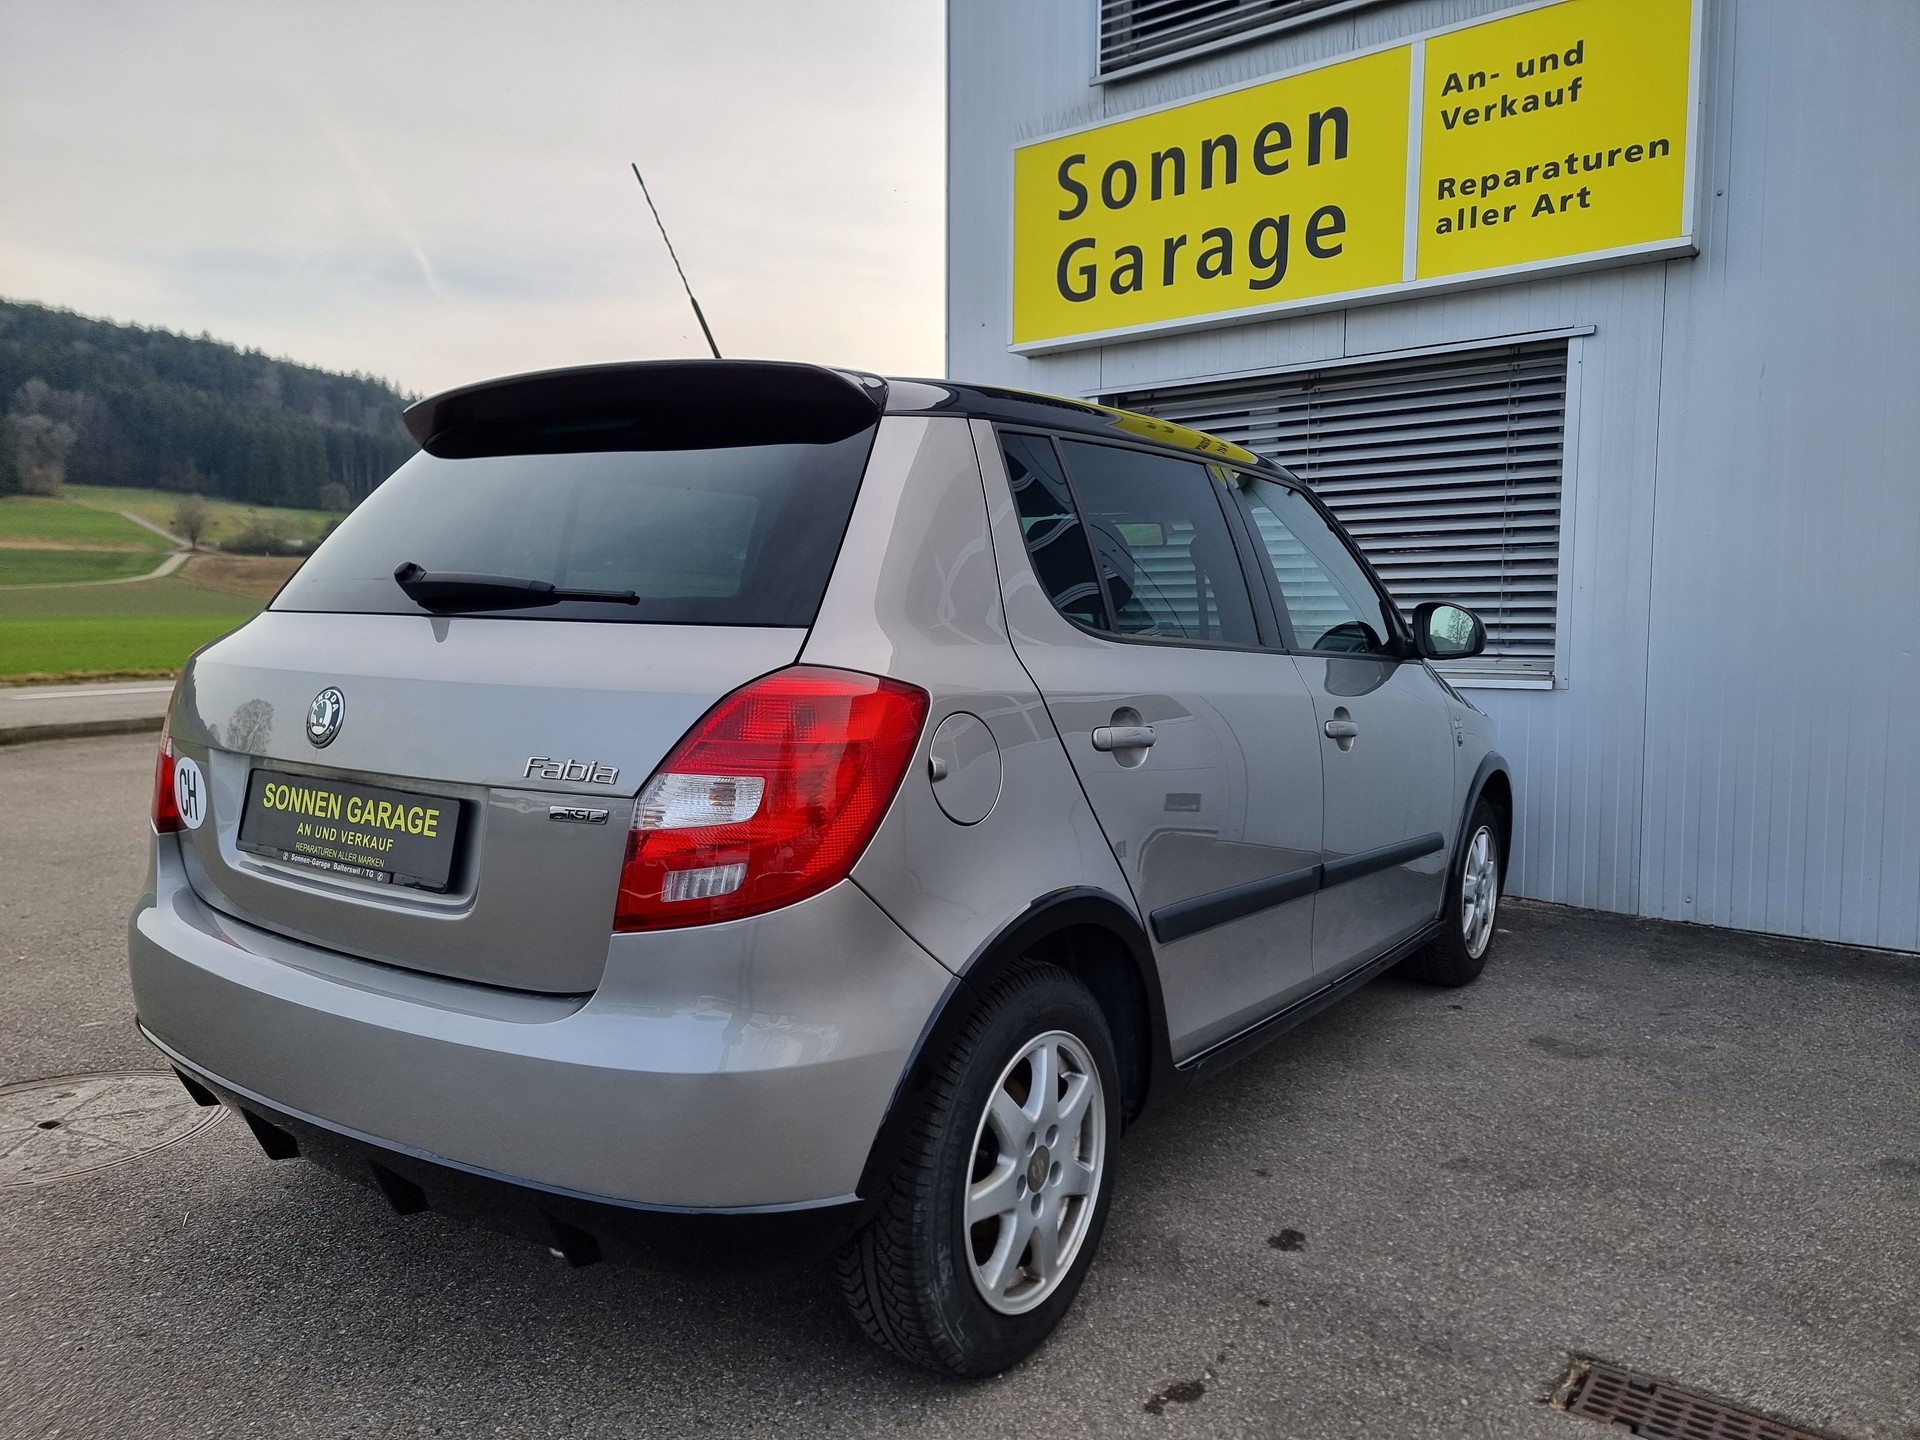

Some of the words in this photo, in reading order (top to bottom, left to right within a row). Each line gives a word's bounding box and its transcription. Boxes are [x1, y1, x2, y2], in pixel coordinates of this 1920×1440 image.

[1441, 71, 1500, 98] An-
[1516, 39, 1585, 79] und
[1441, 77, 1584, 131] Verkauf
[1057, 105, 1350, 221] Sonnen
[1437, 136, 1671, 201] Reparaturen
[1435, 200, 1517, 236] aller
[1531, 186, 1592, 218] Art
[1056, 202, 1347, 303] Garage
[179, 767, 199, 821] CH
[523, 756, 620, 785] Fabia
[263, 782, 342, 820] SONNEN
[346, 797, 440, 838] GARAGE
[297, 822, 312, 836] AN
[315, 826, 337, 841] UND
[341, 830, 394, 852] VERKAUF
[295, 841, 337, 859] REPARATUREN
[337, 850, 357, 862] ALLER
[357, 854, 385, 868] MARKEN
[366, 869, 374, 878] TG
